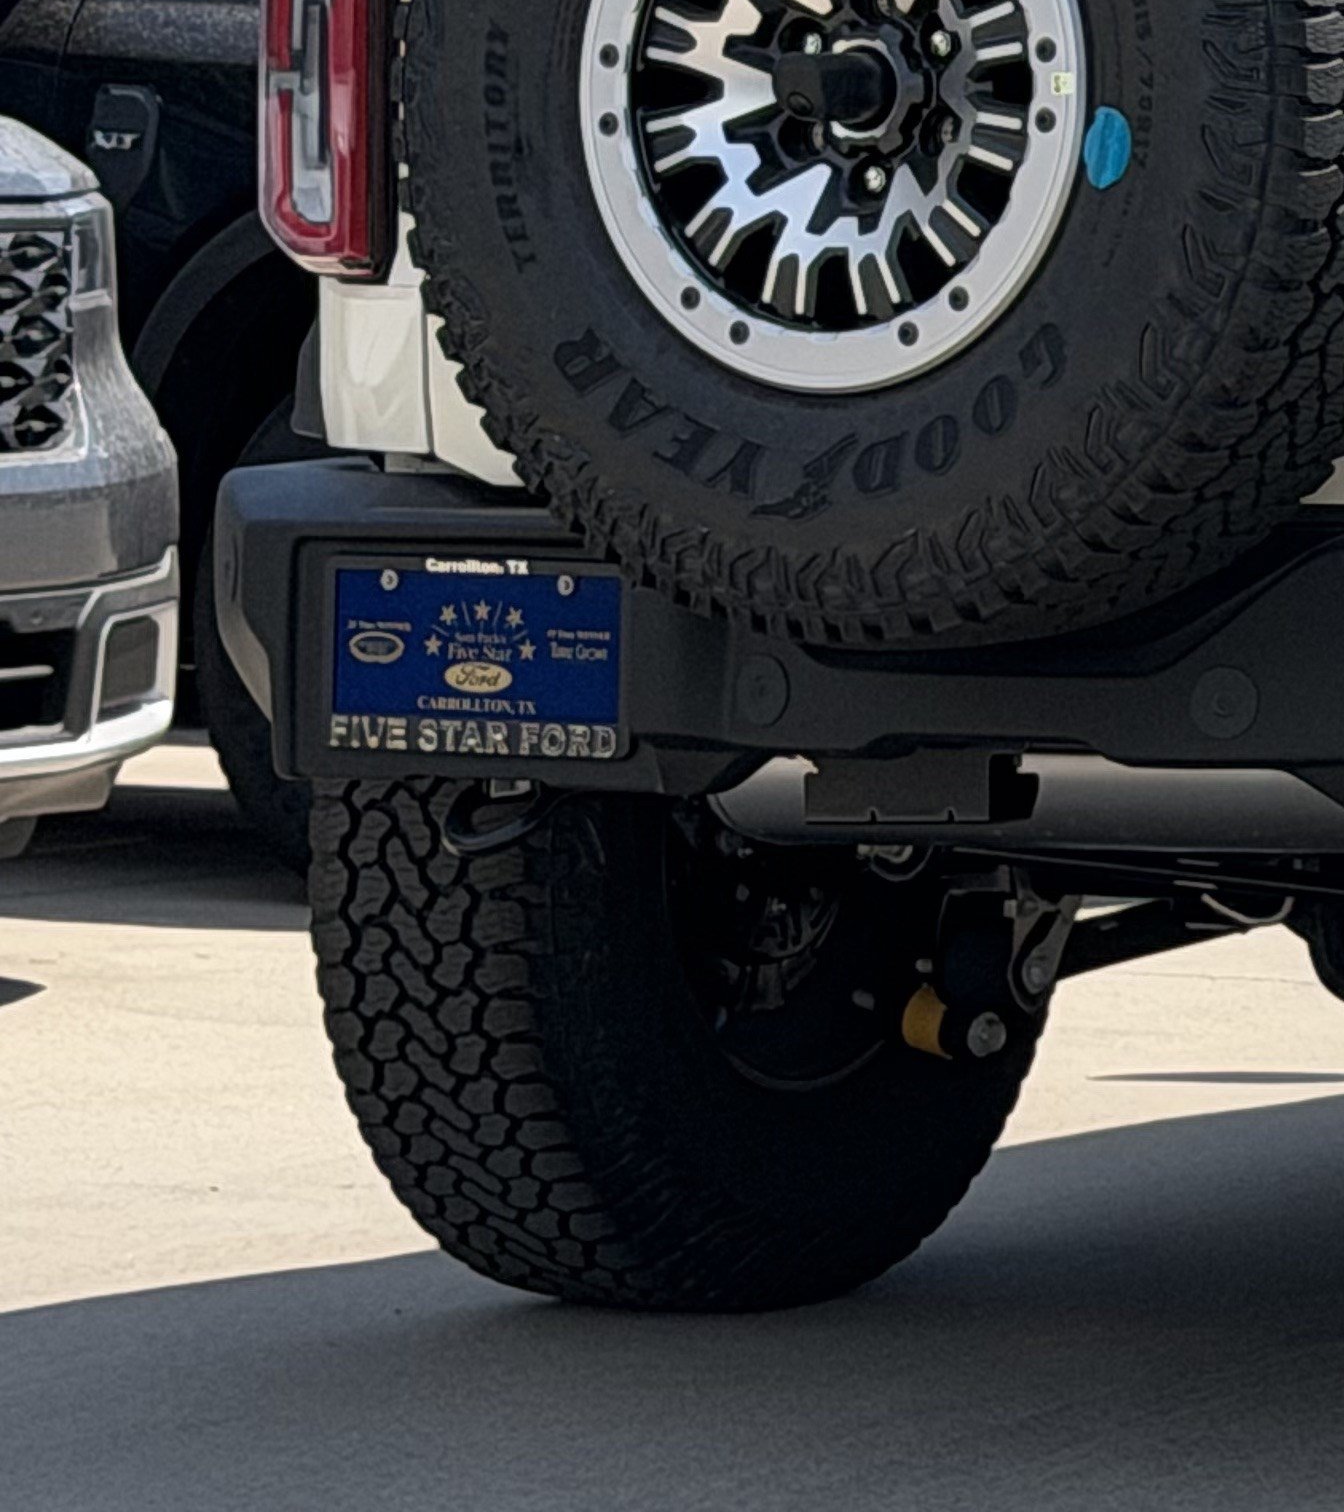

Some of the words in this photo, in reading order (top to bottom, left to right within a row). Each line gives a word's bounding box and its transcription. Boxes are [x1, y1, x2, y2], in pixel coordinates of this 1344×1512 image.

[447, 641, 479, 661] Five
[482, 644, 513, 663] Star
[455, 664, 502, 687] Ford
[328, 714, 408, 751] FIVE
[417, 718, 510, 755] STAR
[518, 722, 618, 759] FORD
